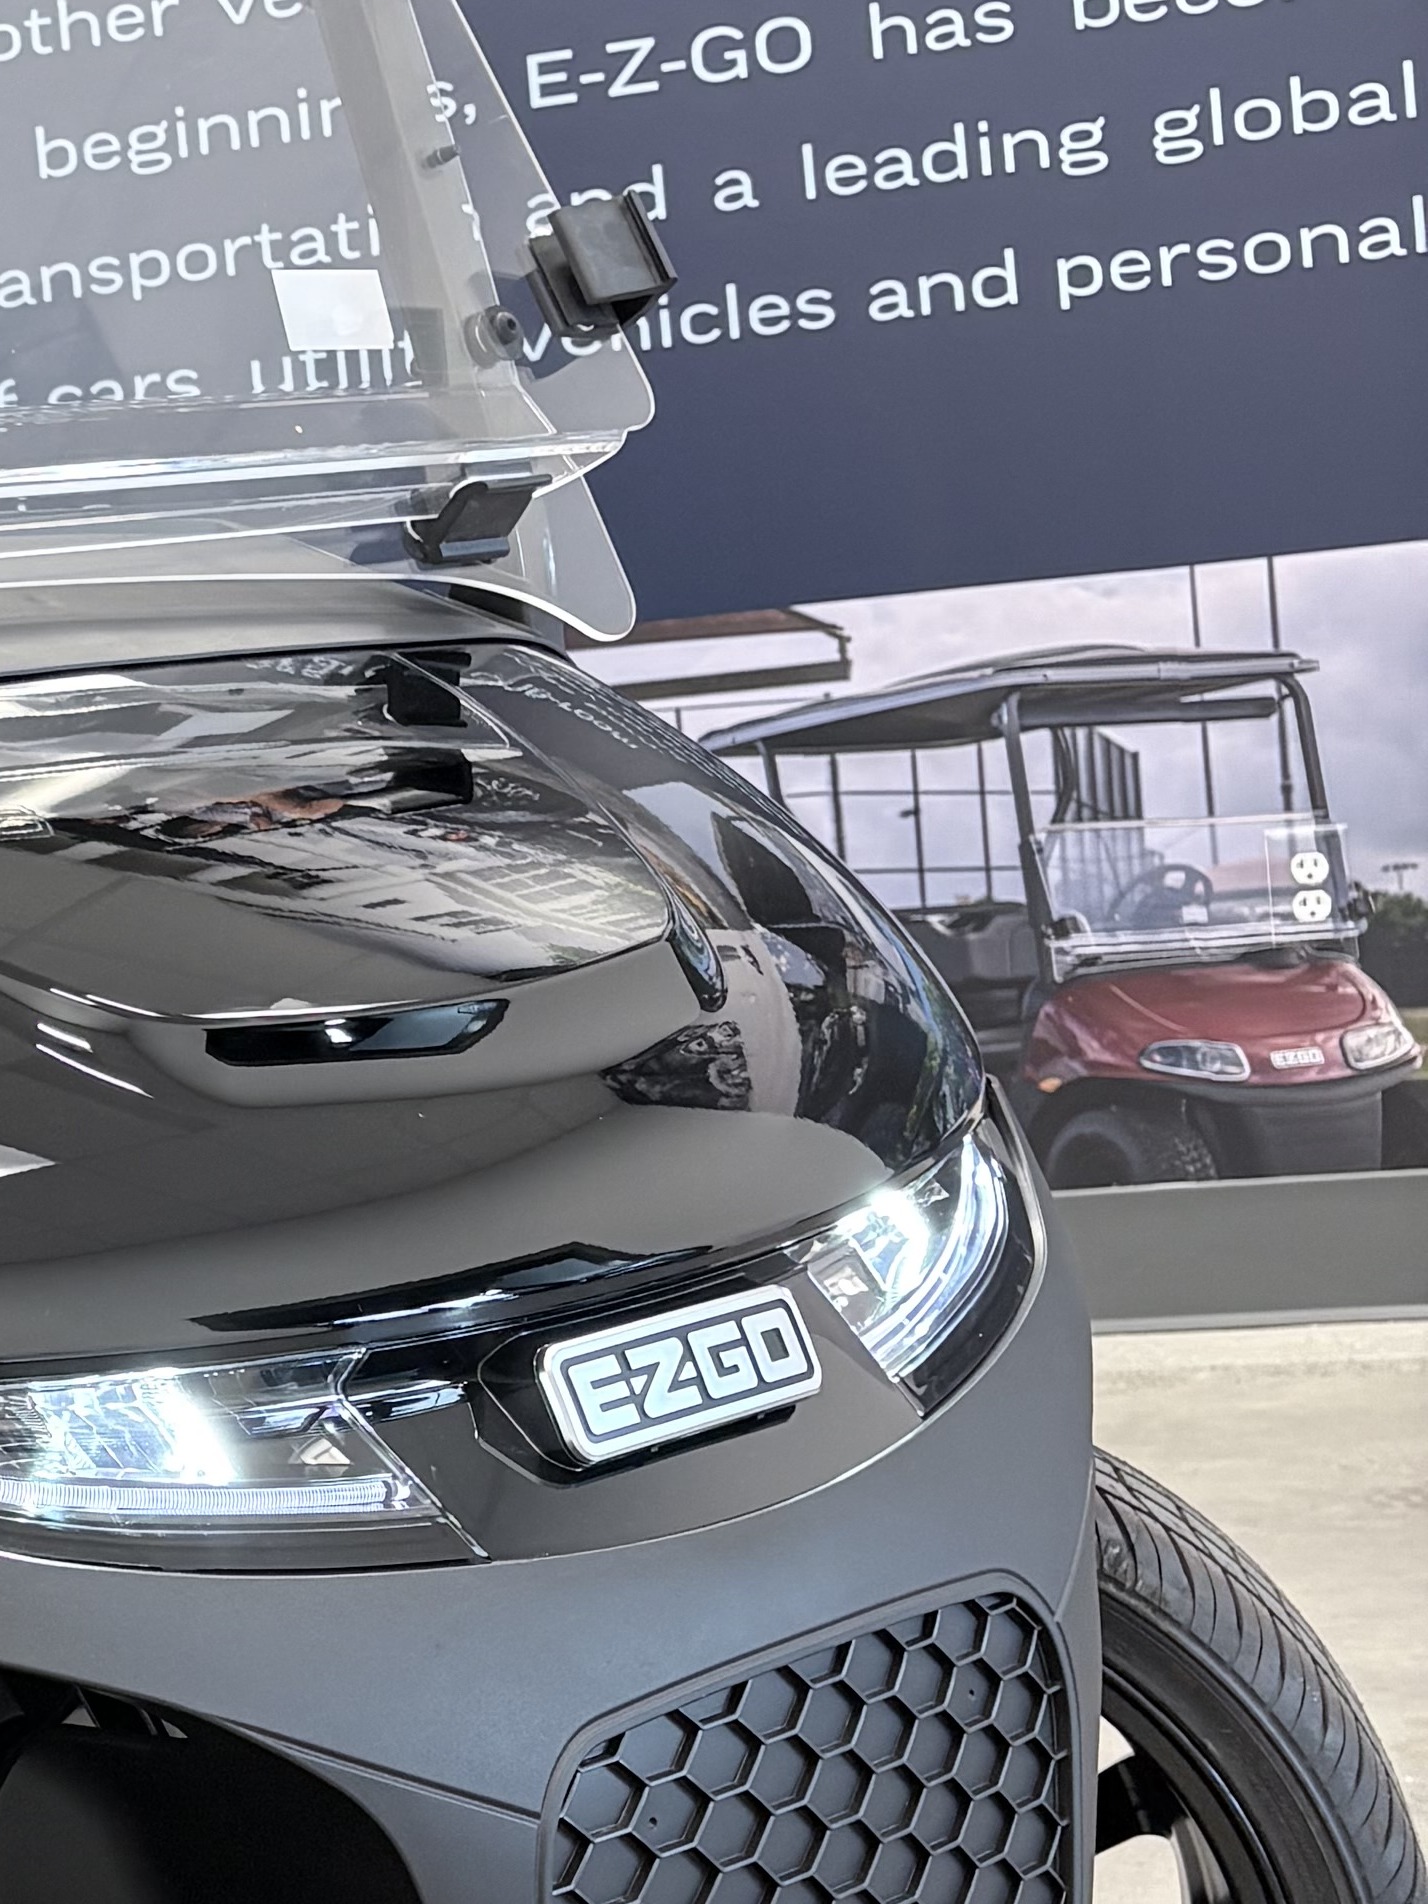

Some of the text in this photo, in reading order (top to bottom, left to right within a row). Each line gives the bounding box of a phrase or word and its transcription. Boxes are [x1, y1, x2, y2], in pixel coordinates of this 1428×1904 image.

[35, 81, 477, 182] beginnins,
[526, 17, 812, 108] E-Z-GO
[869, 2, 1014, 59] has
[714, 170, 759, 211] a
[802, 116, 1108, 199] leading
[1153, 60, 1417, 164] global
[869, 248, 1018, 321] and
[1057, 195, 1428, 310] personal
